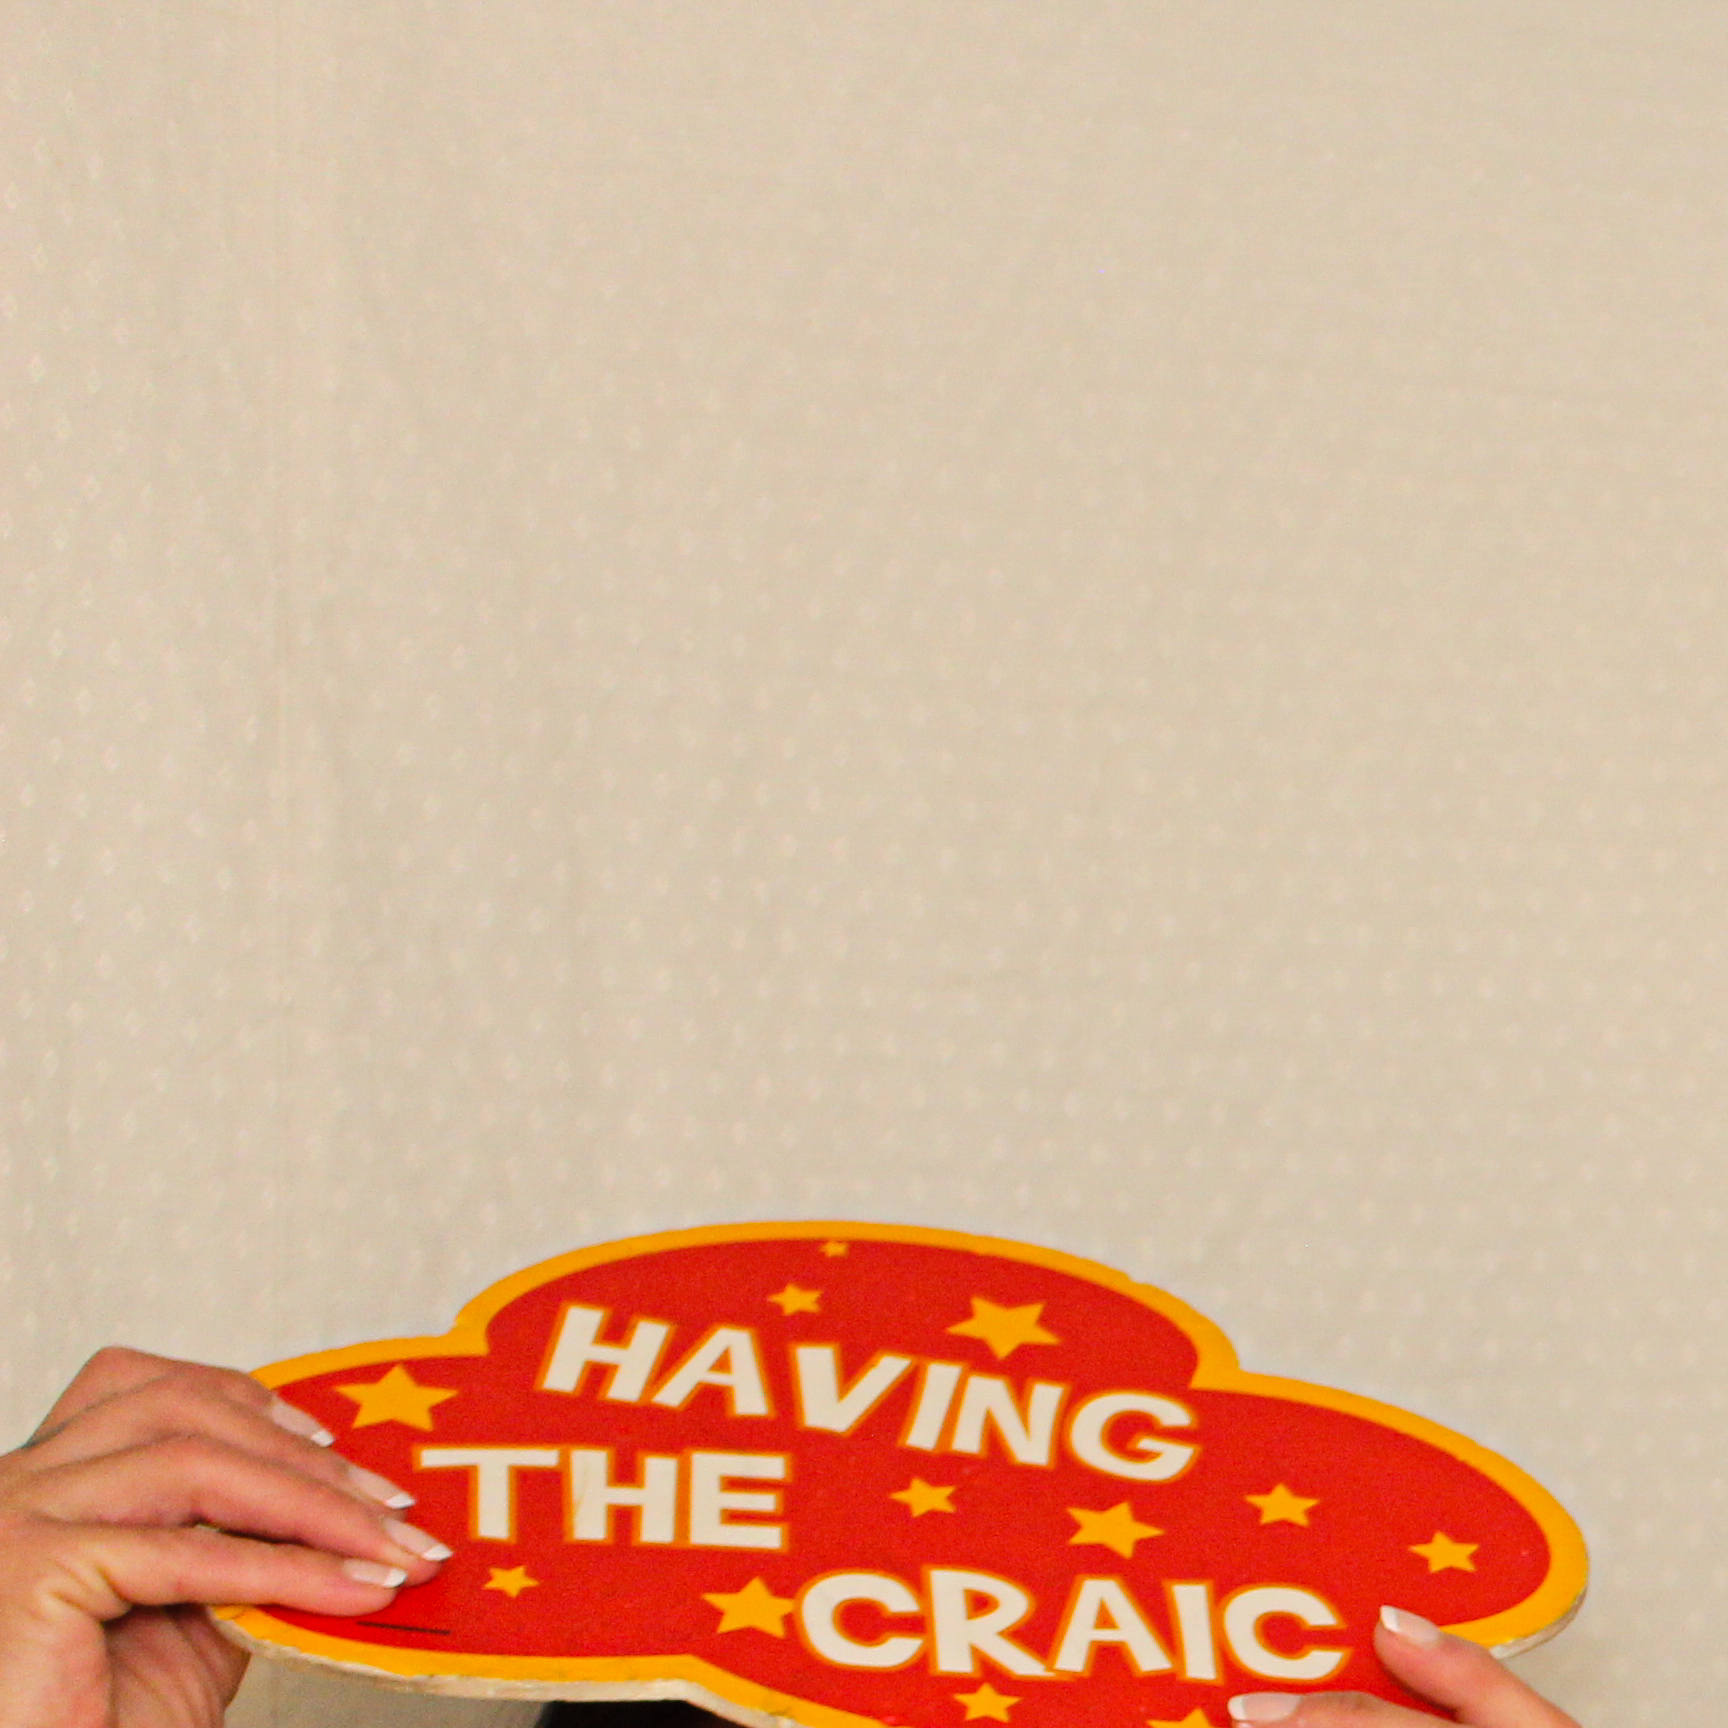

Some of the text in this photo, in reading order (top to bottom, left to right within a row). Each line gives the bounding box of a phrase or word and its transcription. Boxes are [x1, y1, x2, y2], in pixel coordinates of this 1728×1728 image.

[541, 1306, 1198, 1482] HAVING
[418, 1447, 789, 1550] THE
[800, 1567, 1350, 1682] CRAIC
